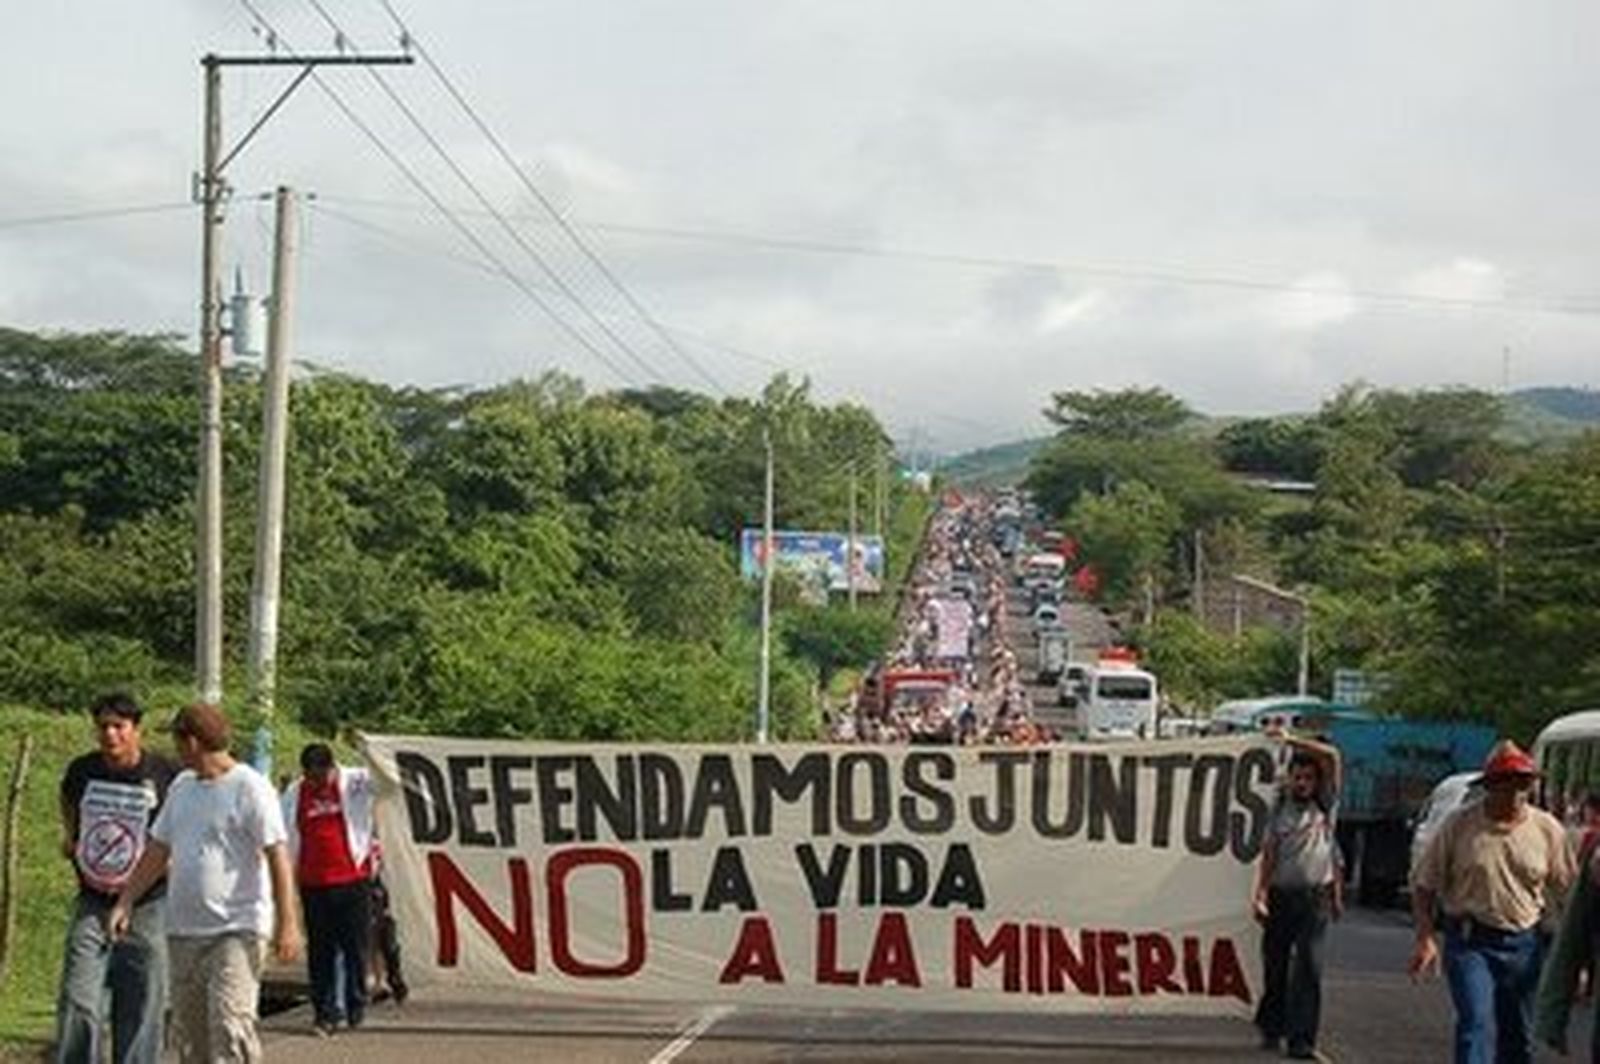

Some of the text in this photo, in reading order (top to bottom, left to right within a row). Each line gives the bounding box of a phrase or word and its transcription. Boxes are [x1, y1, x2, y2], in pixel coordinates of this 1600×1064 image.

[396, 747, 1275, 863] DEFENDAMOS JUNTOS
[427, 847, 1252, 1001] NO A LA MINERIA
[652, 843, 985, 912] LA VIDA
